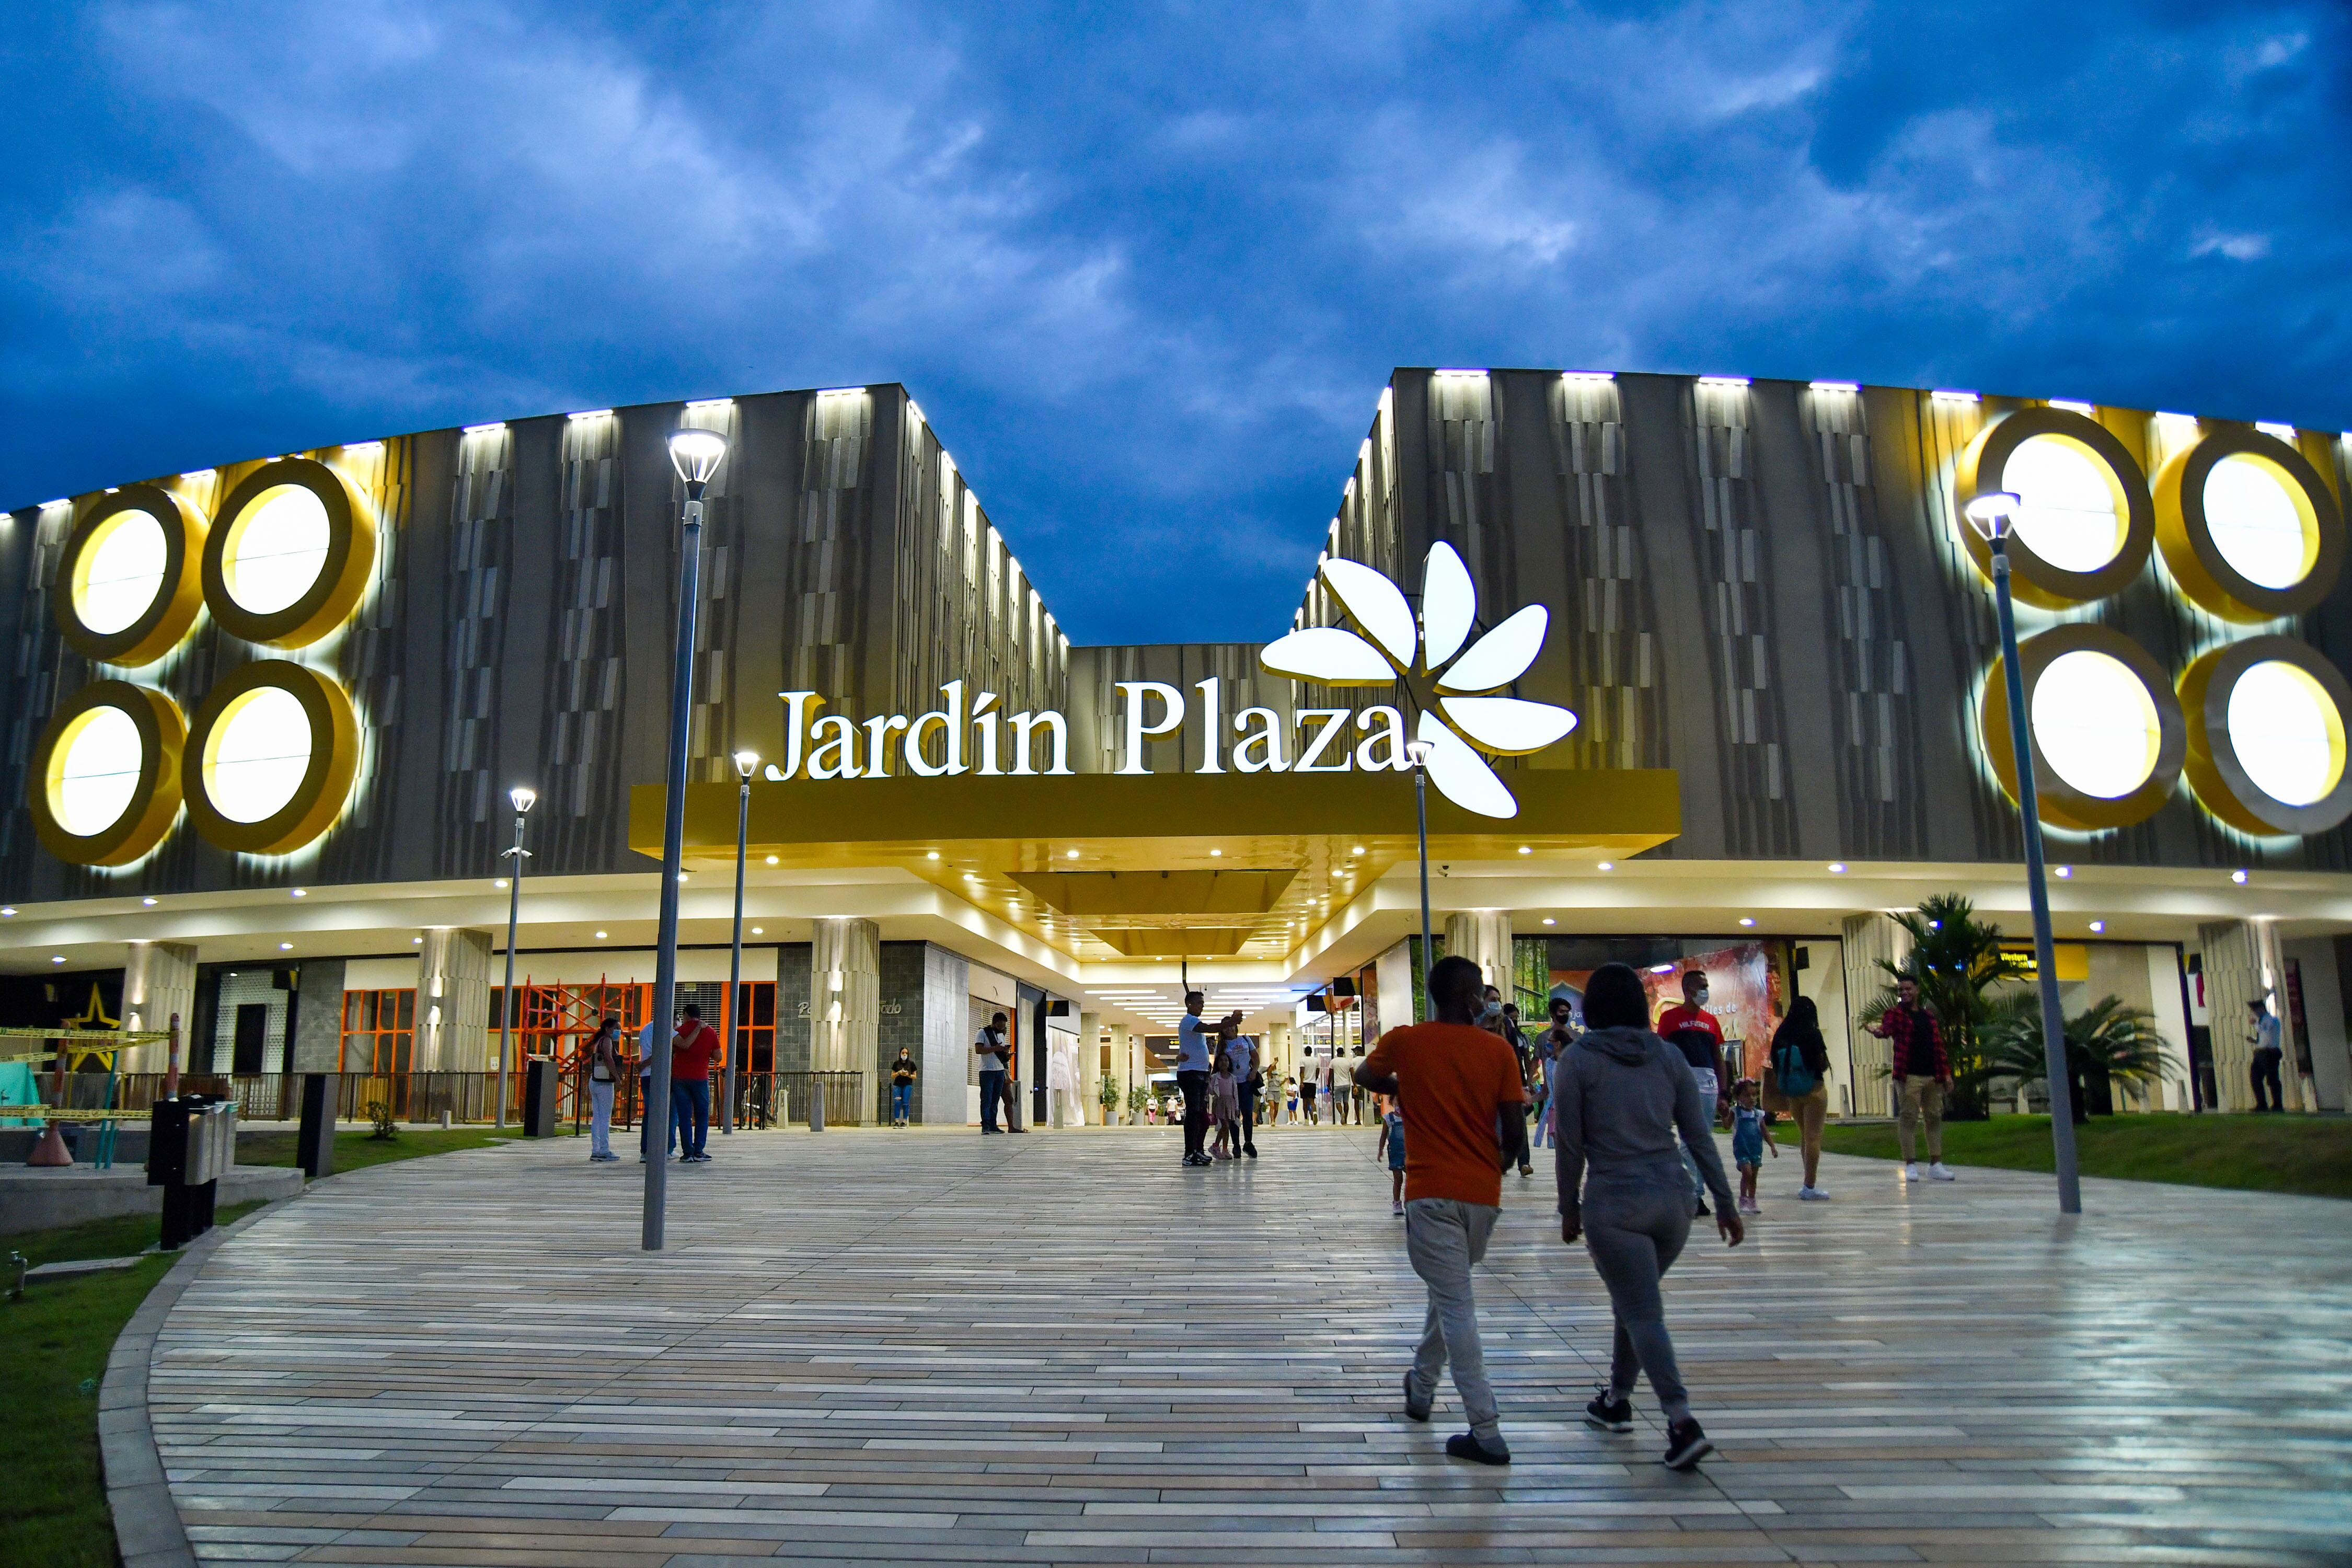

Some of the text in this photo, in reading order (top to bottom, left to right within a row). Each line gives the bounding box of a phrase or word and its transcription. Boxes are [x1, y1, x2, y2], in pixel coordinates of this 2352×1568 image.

[765, 676, 1414, 781] Jardín Plaza
[2000, 953, 2028, 961] Western
[1726, 1002, 1737, 1013] de
